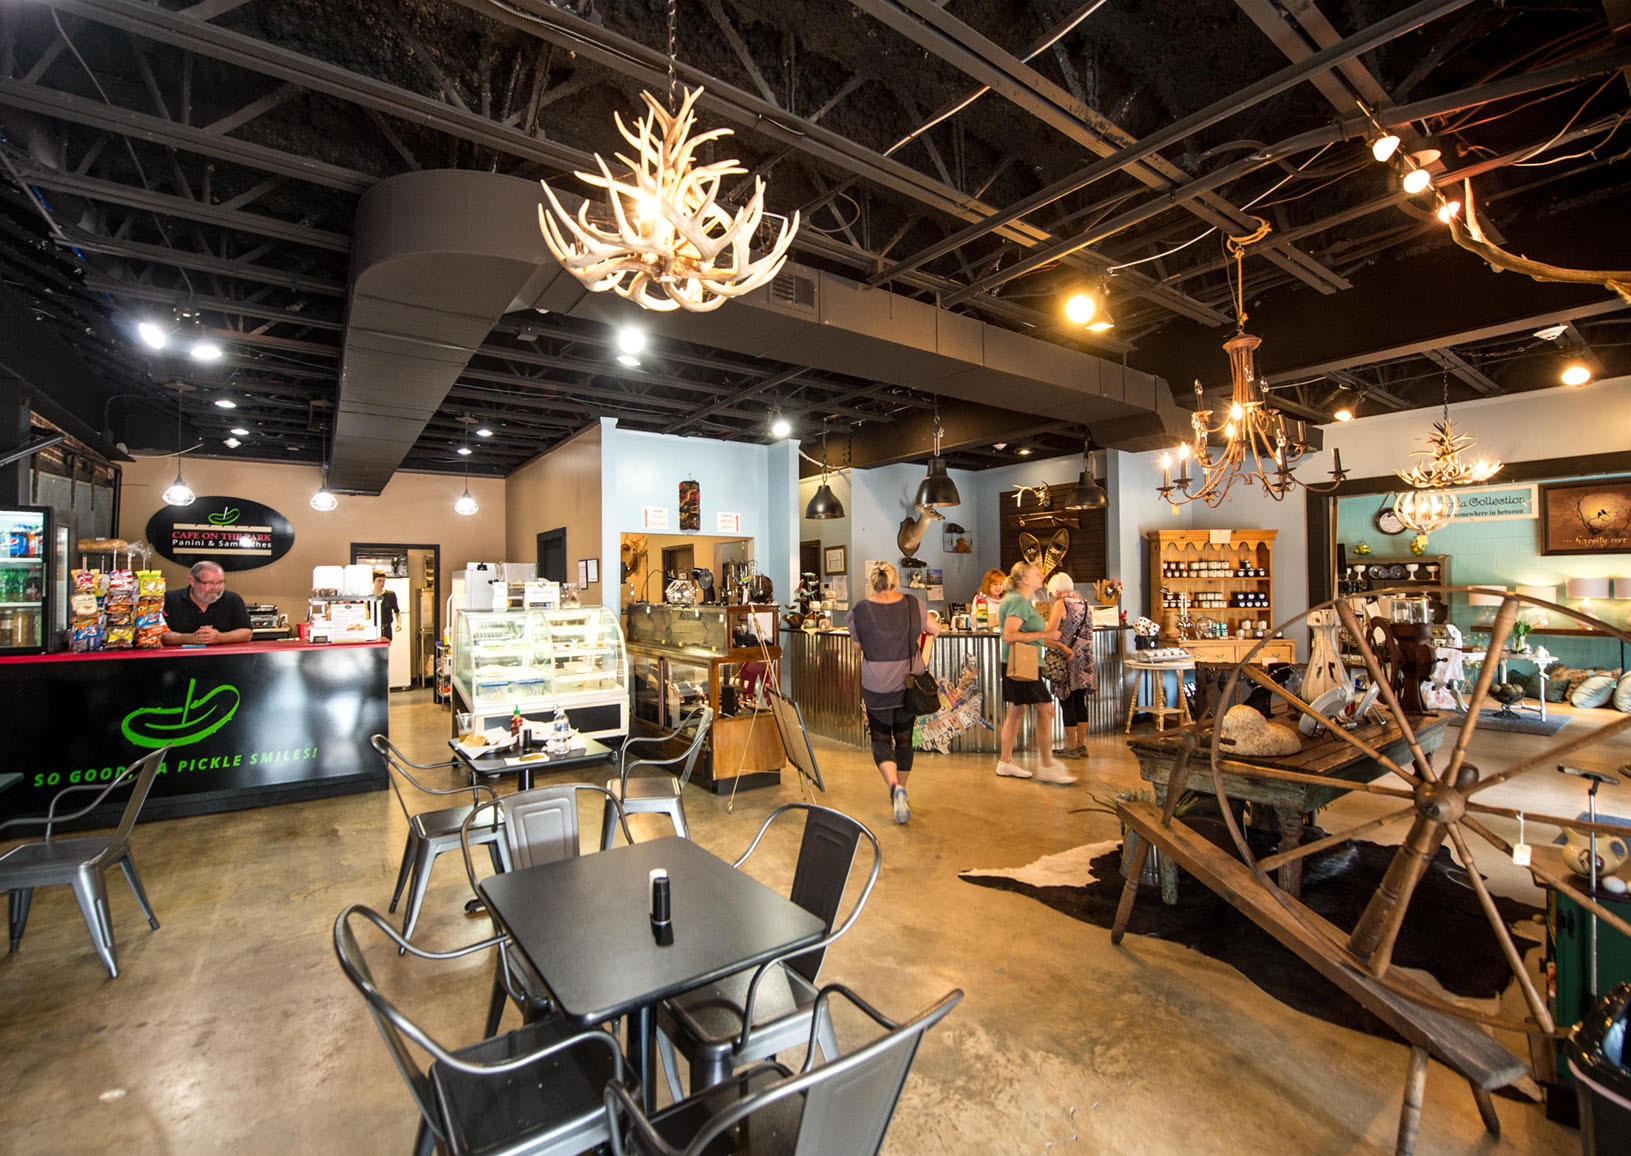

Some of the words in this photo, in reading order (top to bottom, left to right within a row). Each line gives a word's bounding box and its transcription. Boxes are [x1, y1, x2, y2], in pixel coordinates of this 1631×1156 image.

[1469, 495, 1525, 507] Collection
[1497, 508, 1524, 516] between
[172, 531, 199, 540] CAFE
[201, 532, 218, 540] ON
[220, 532, 241, 541] THE
[244, 533, 272, 542] PARK
[172, 539, 204, 547] Panini
[156, 762, 168, 775] A
[177, 754, 243, 773] PICKLE
[249, 747, 319, 766] SMILES!
[33, 773, 61, 788] SO
